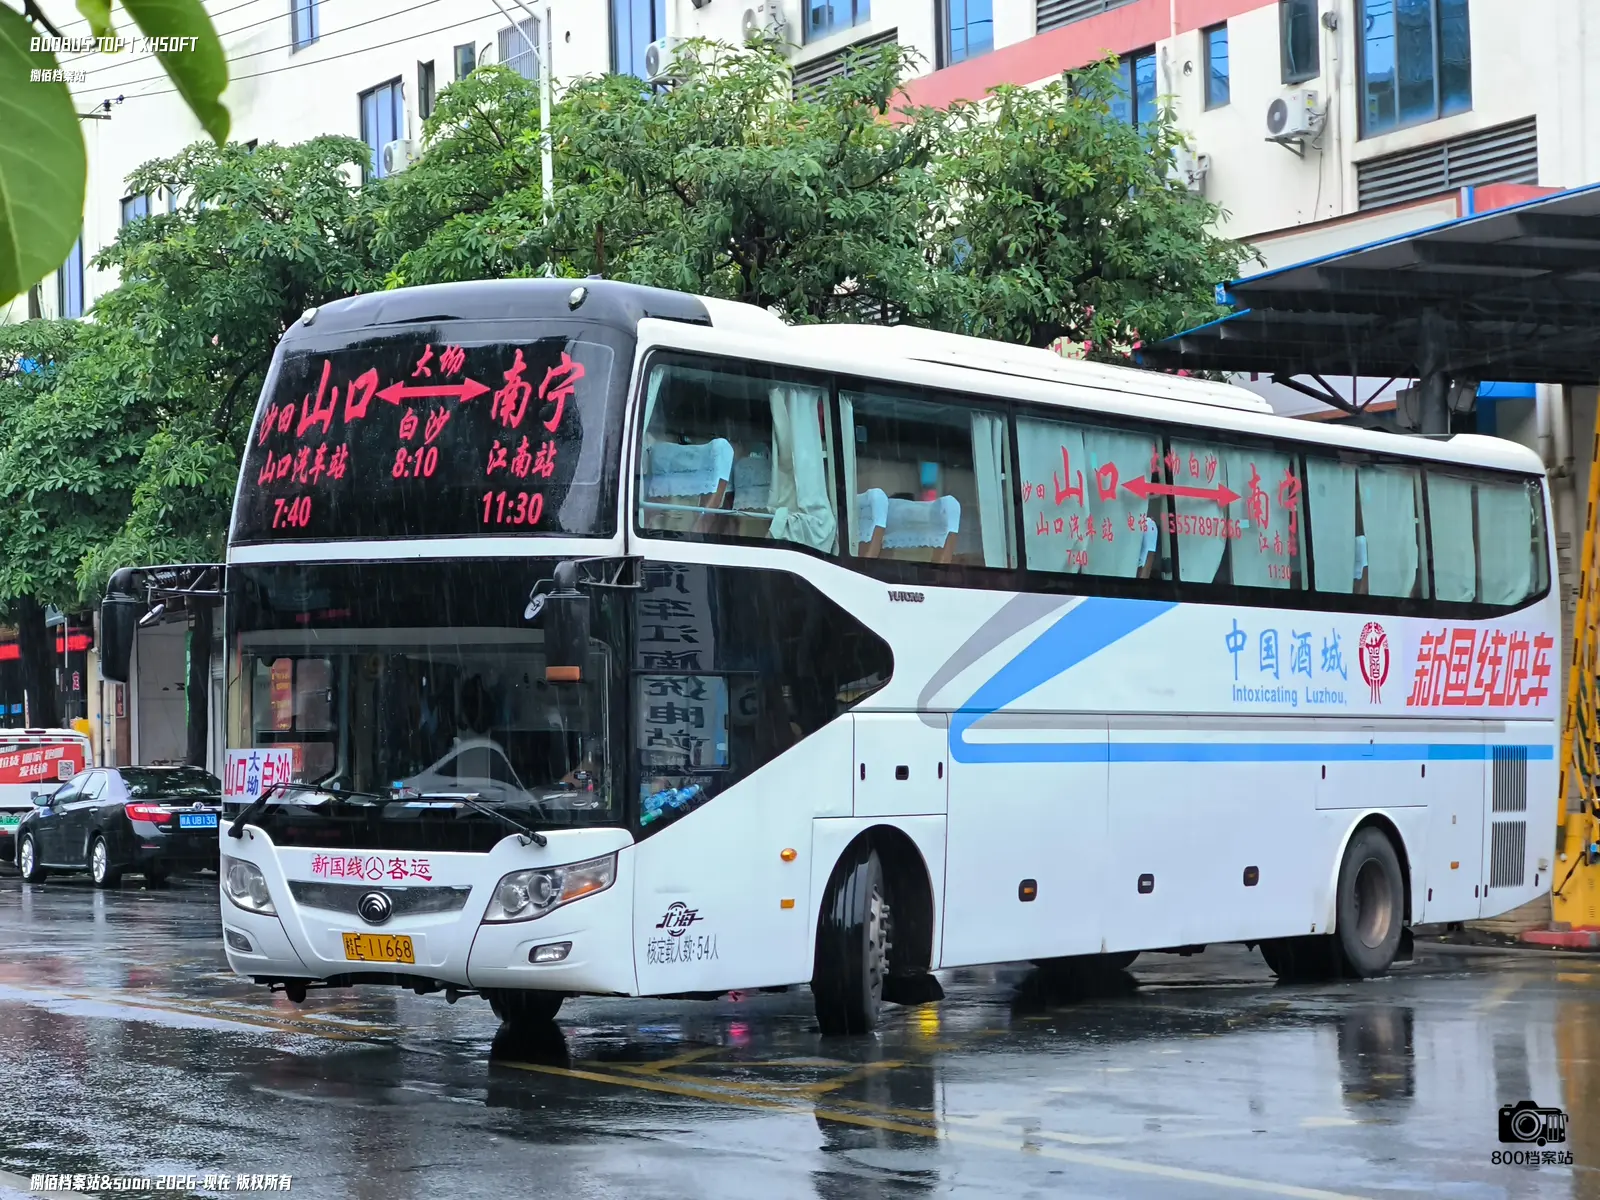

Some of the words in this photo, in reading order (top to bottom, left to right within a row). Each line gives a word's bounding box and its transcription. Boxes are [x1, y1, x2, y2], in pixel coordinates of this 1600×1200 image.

[297, 359, 379, 437] 山口
[491, 348, 585, 432] 南宁
[399, 406, 451, 445] 白沙
[257, 442, 348, 486] 山口汽车站
[392, 446, 438, 478] 8:10
[486, 435, 557, 478] 江南站
[1053, 445, 1119, 508] 山口
[1246, 463, 1302, 534] 南宁
[271, 496, 312, 529] 7:40
[482, 490, 544, 525] 11:30
[1036, 511, 1114, 545] 山口汽车站
[1066, 549, 1088, 567] 7:40
[1267, 564, 1292, 580] 11:30
[1225, 618, 1348, 681] 中国酒城
[1406, 627, 1554, 707] 新国线快车
[1233, 684, 1298, 707] Intoxicating
[312, 854, 365, 880] 新国线
[387, 857, 432, 881] 客运
[656, 908, 704, 929] 北海
